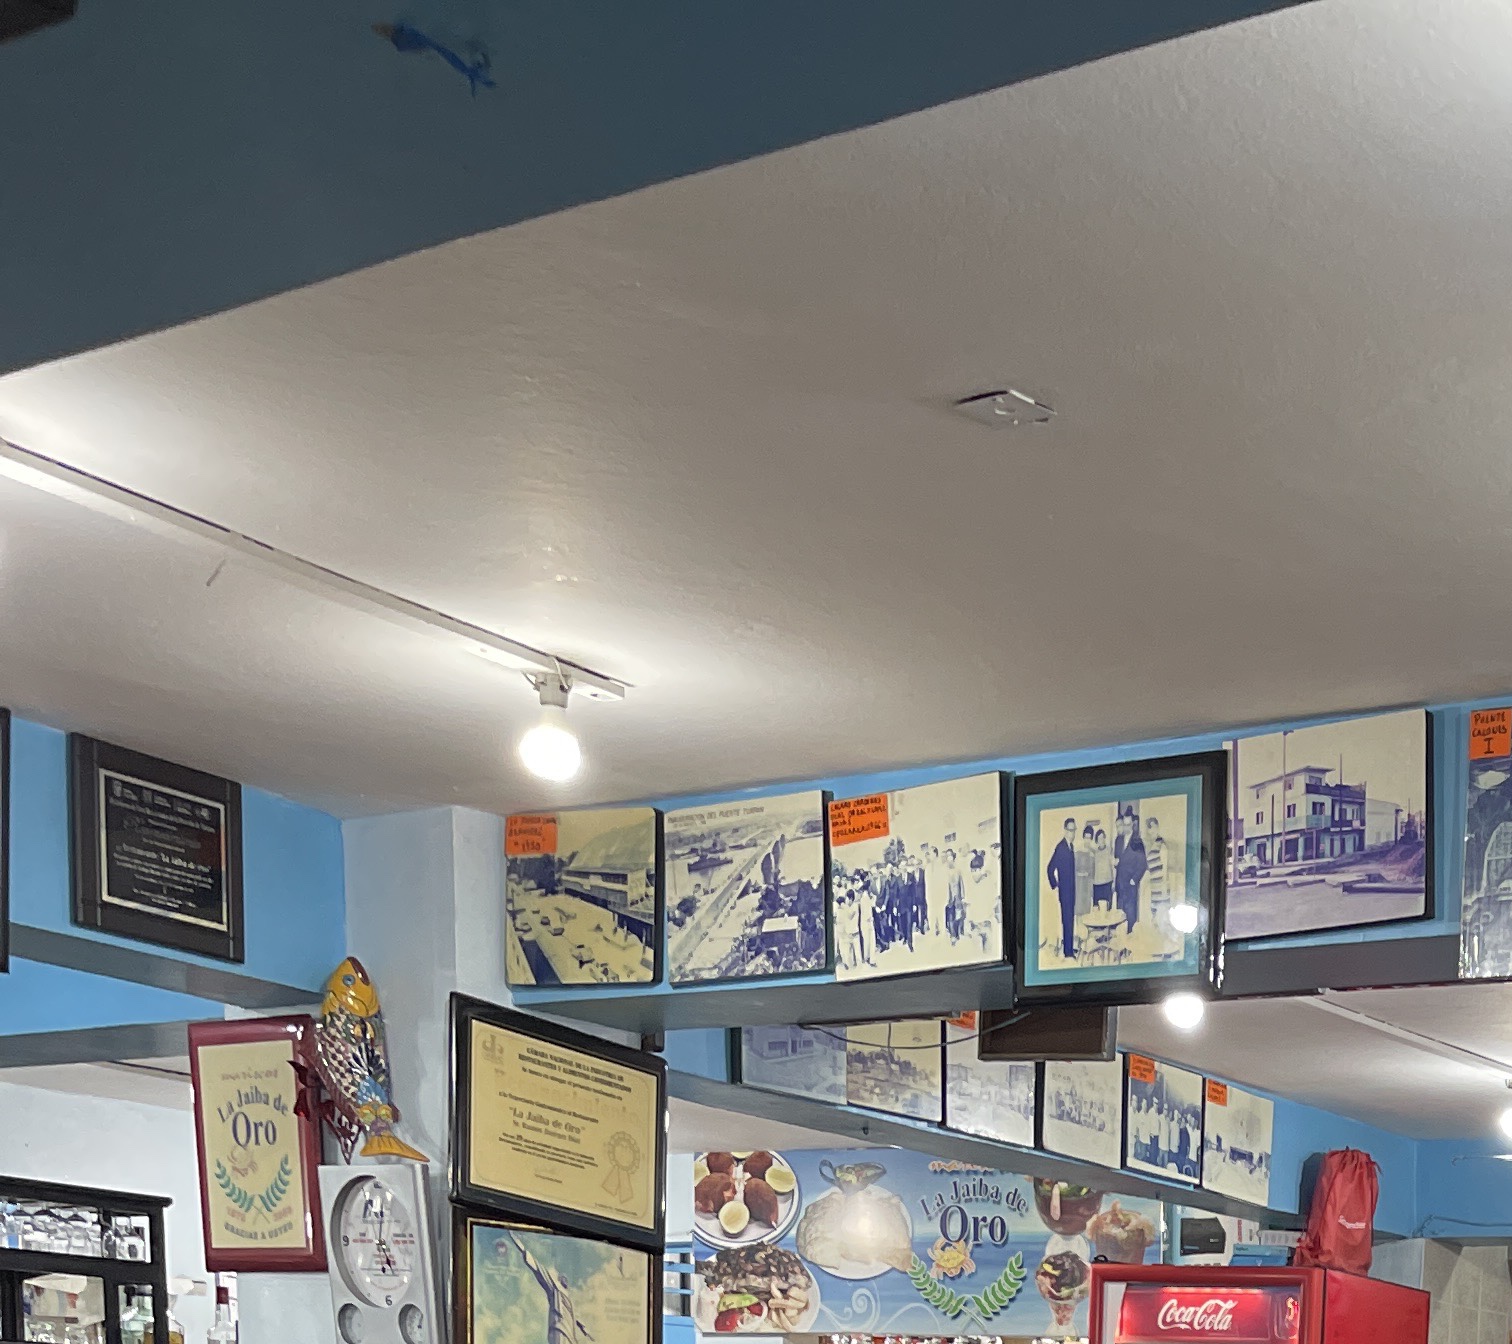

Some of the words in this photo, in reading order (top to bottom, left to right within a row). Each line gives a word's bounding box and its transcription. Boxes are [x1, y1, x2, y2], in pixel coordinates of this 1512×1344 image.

[217, 1101, 235, 1124] La
[237, 1085, 270, 1109] Jaiba
[273, 1093, 290, 1118] de
[231, 1111, 278, 1149] Oro
[920, 1192, 945, 1218] La
[950, 1177, 1000, 1203] Jaiba
[1005, 1187, 1028, 1213] de
[940, 1204, 1007, 1243] Oro
